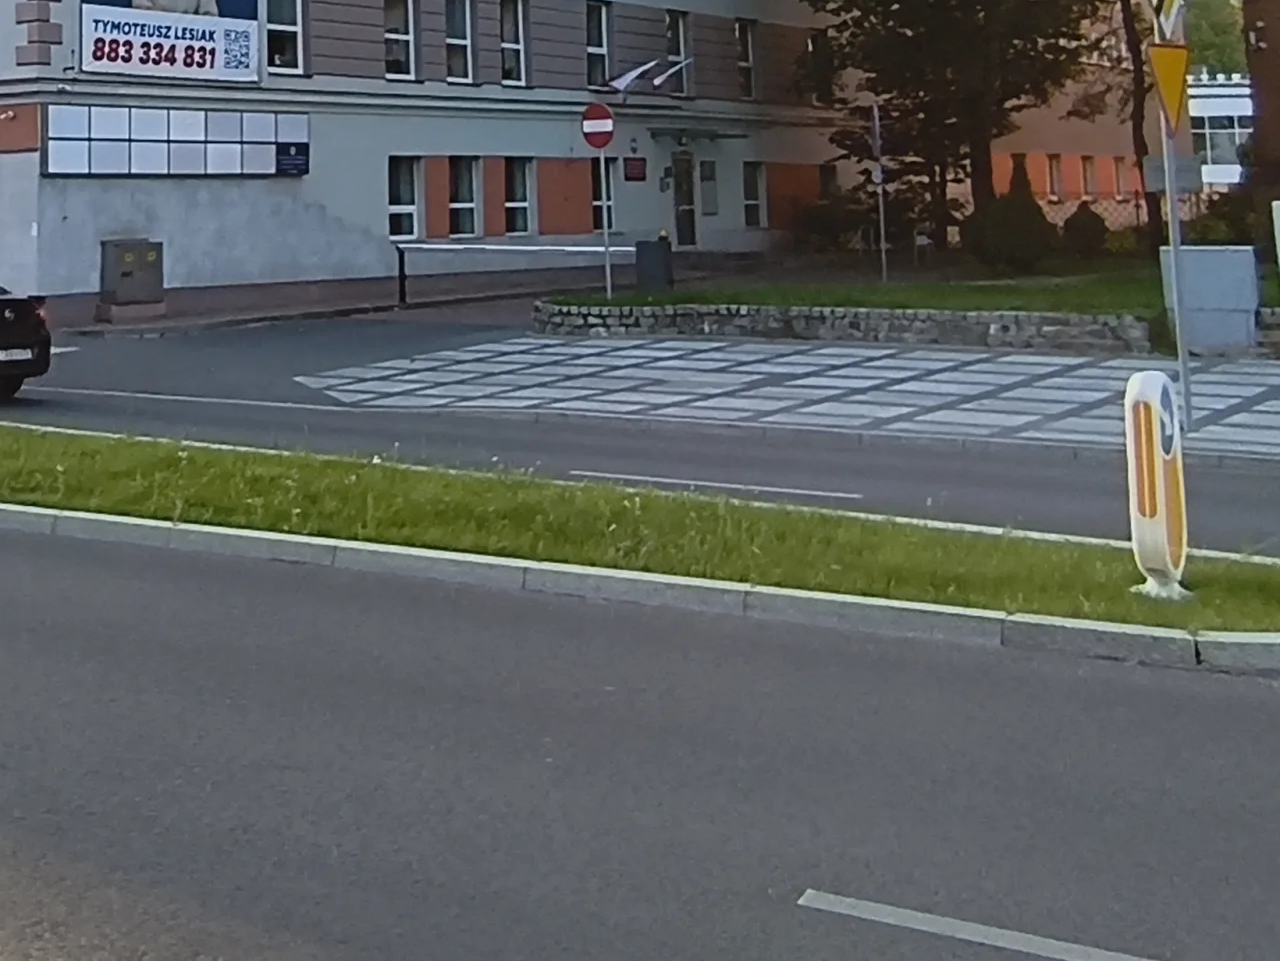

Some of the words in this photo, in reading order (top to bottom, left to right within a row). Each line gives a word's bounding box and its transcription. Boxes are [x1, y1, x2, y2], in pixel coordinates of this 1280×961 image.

[92, 18, 171, 40] TYMOTEUSZ
[174, 25, 217, 43] LESIAK
[92, 37, 134, 65] 883
[138, 42, 177, 67] 334
[182, 44, 217, 70] 831
